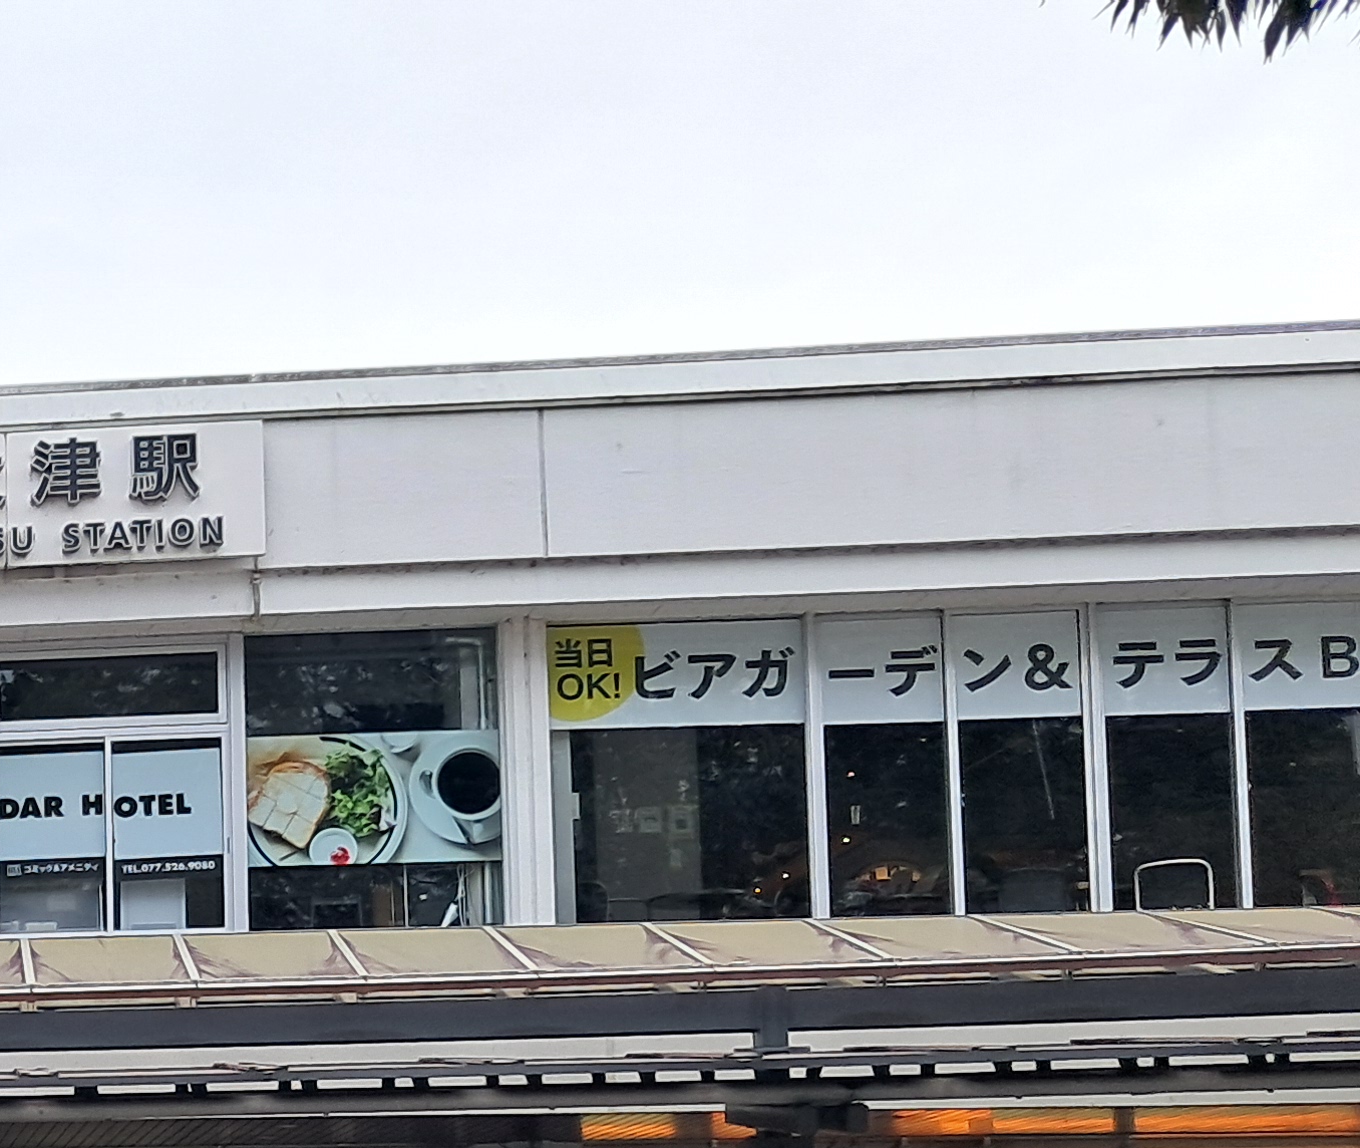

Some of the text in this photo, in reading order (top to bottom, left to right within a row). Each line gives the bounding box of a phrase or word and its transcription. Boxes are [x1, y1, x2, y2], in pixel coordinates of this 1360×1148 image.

[61, 515, 225, 554] STATION
[555, 638, 613, 669] 当日
[557, 673, 621, 701] OK!
